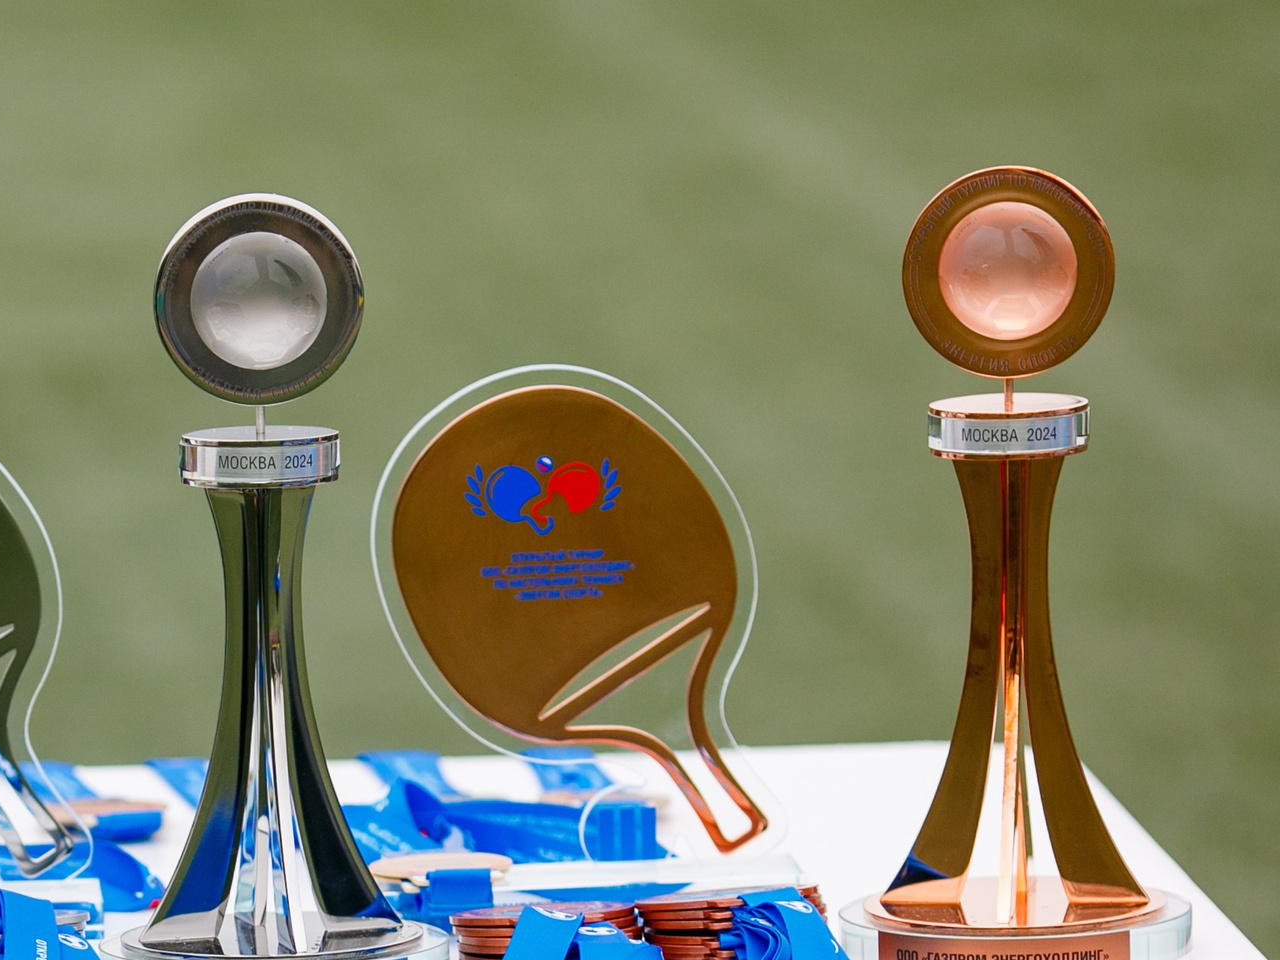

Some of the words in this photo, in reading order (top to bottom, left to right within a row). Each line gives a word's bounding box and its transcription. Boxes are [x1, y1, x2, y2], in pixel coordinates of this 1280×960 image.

[955, 174, 1005, 199] ТУРНИР
[1009, 173, 1028, 186] ПО
[961, 428, 1019, 442] МОСКВА
[1027, 426, 1057, 442] 2024
[218, 455, 277, 470] МОСКВА
[284, 453, 314, 469] 2024
